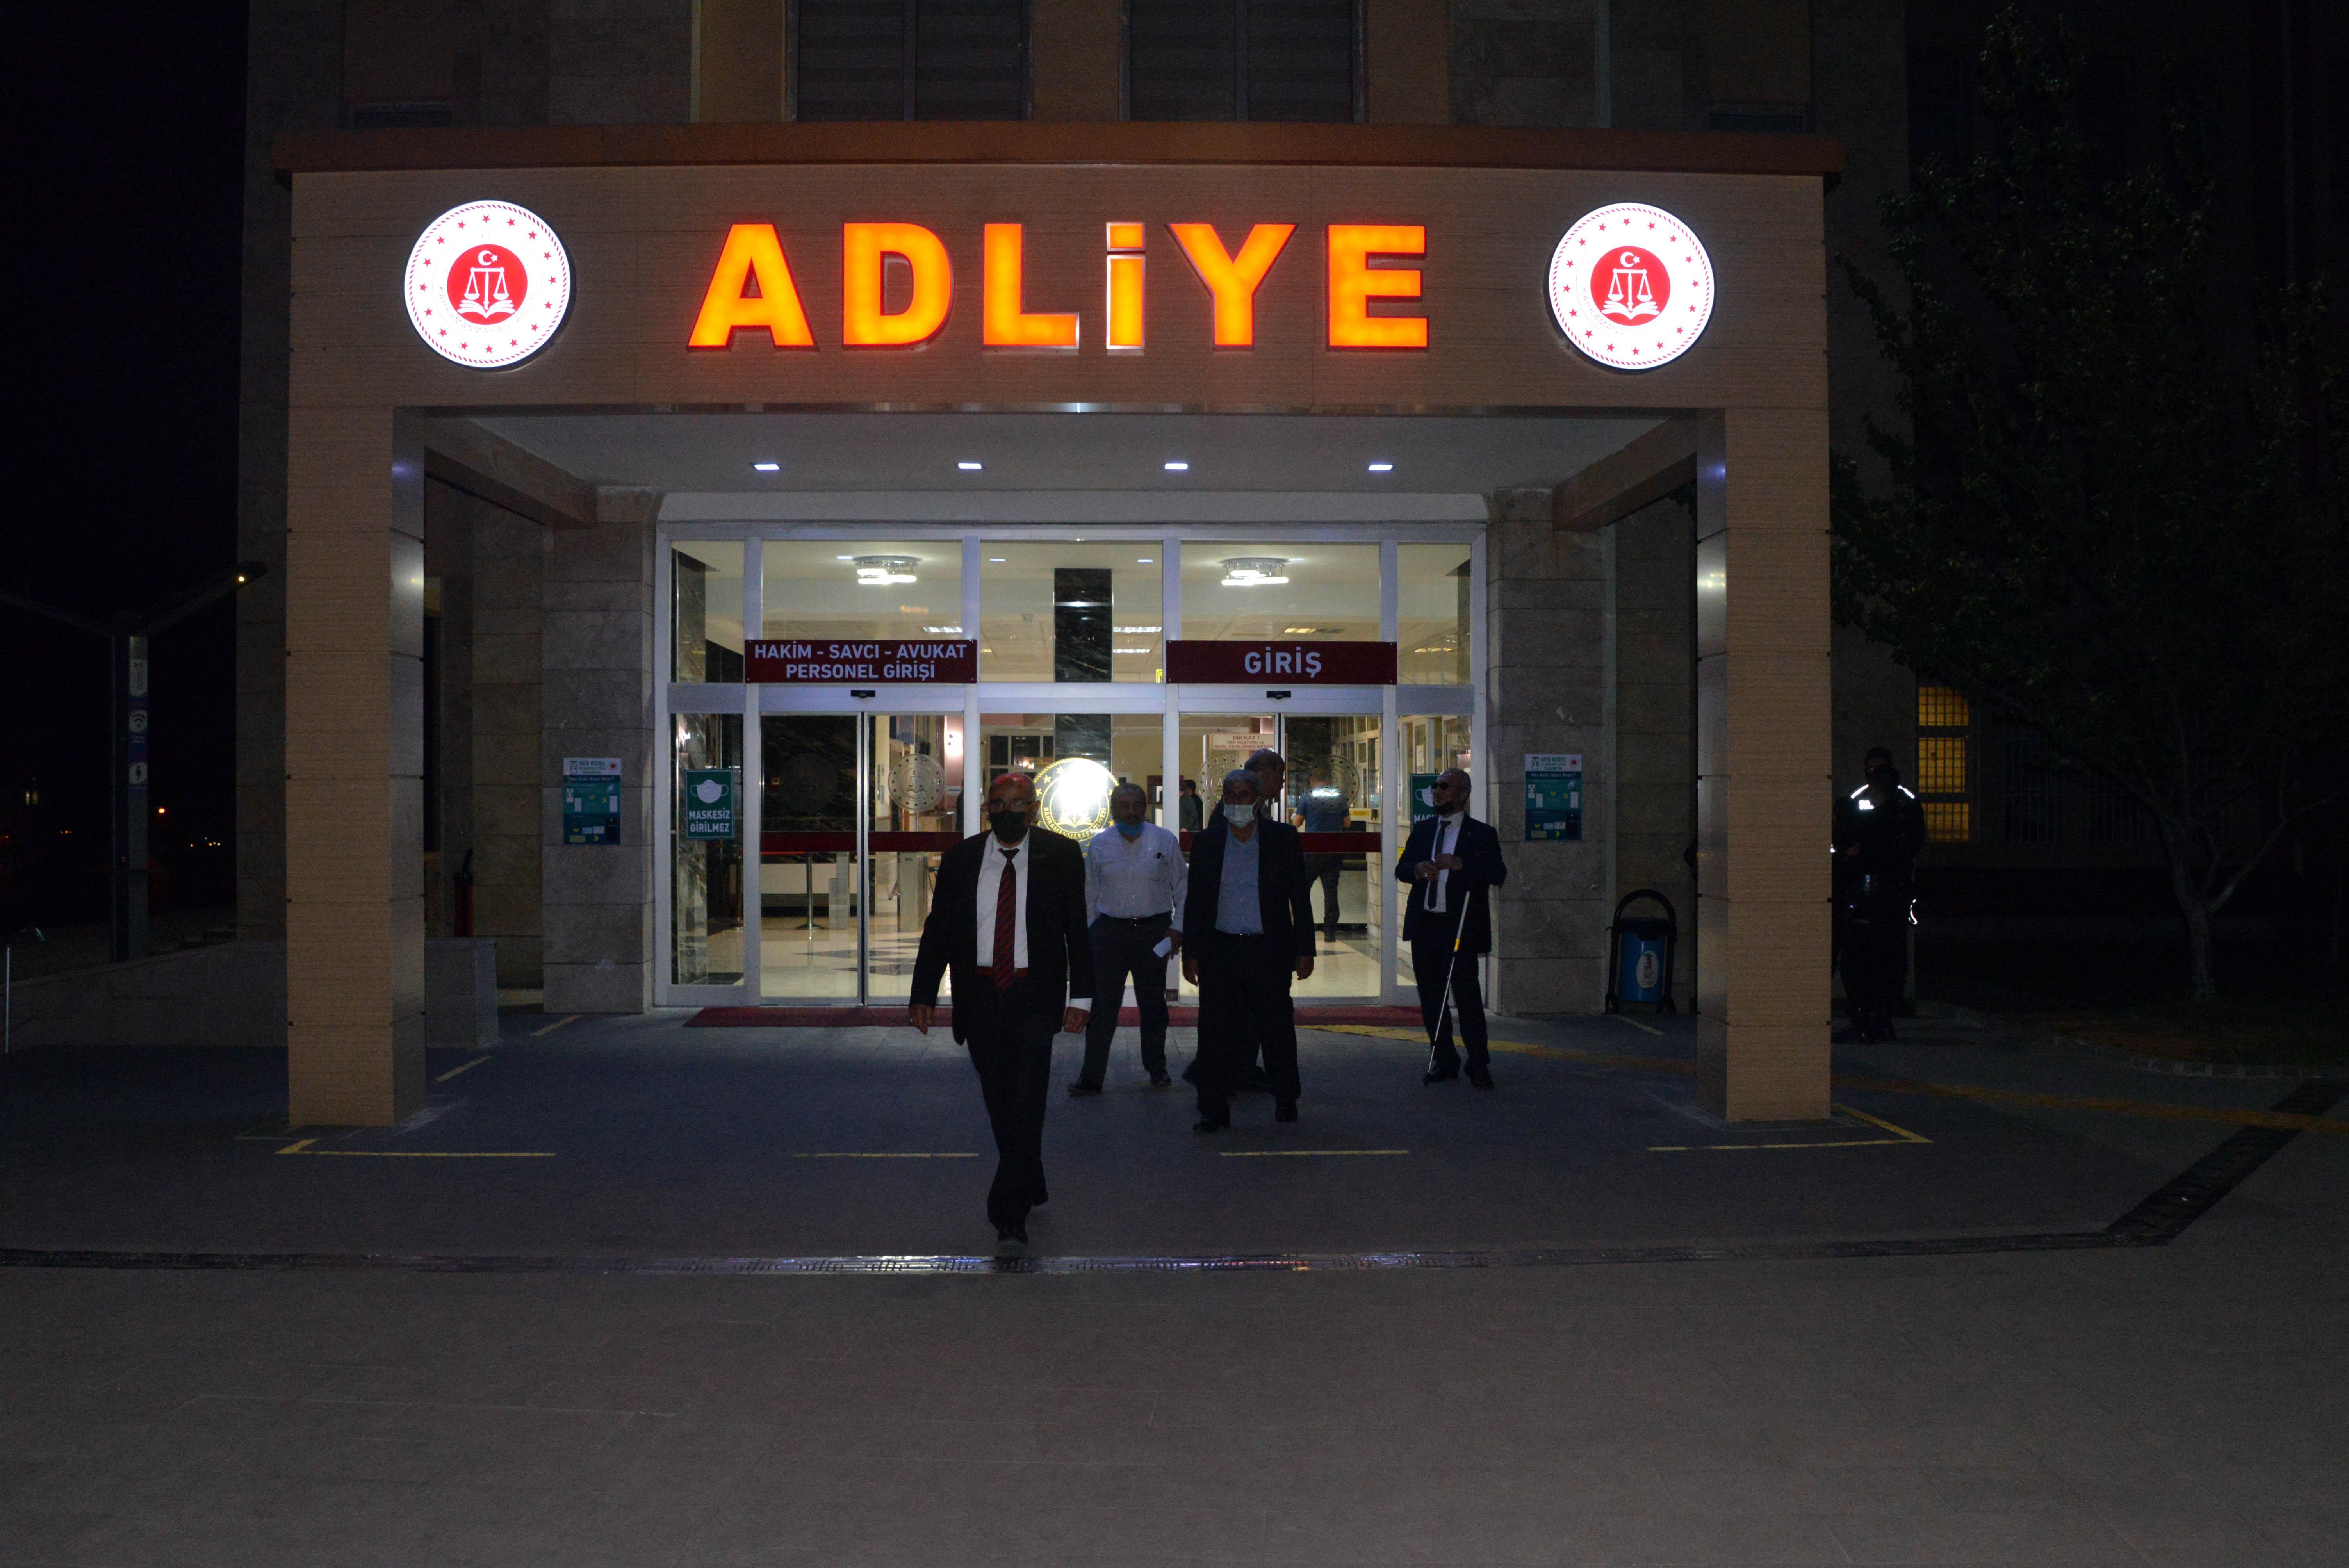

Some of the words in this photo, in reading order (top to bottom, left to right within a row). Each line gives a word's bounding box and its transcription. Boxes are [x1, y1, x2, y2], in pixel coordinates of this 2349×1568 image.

[687, 221, 1429, 349] ADLİYE
[755, 641, 811, 659] HAKİM
[829, 644, 879, 659] SAVCI
[897, 644, 967, 659] AVUKAT
[786, 663, 879, 679] PERSONEL
[884, 660, 935, 681] GİRİŞİ
[1244, 646, 1322, 678] GİRİŞ
[689, 807, 731, 820] MASKESİZ
[690, 821, 729, 833] GİRİLMEZ
